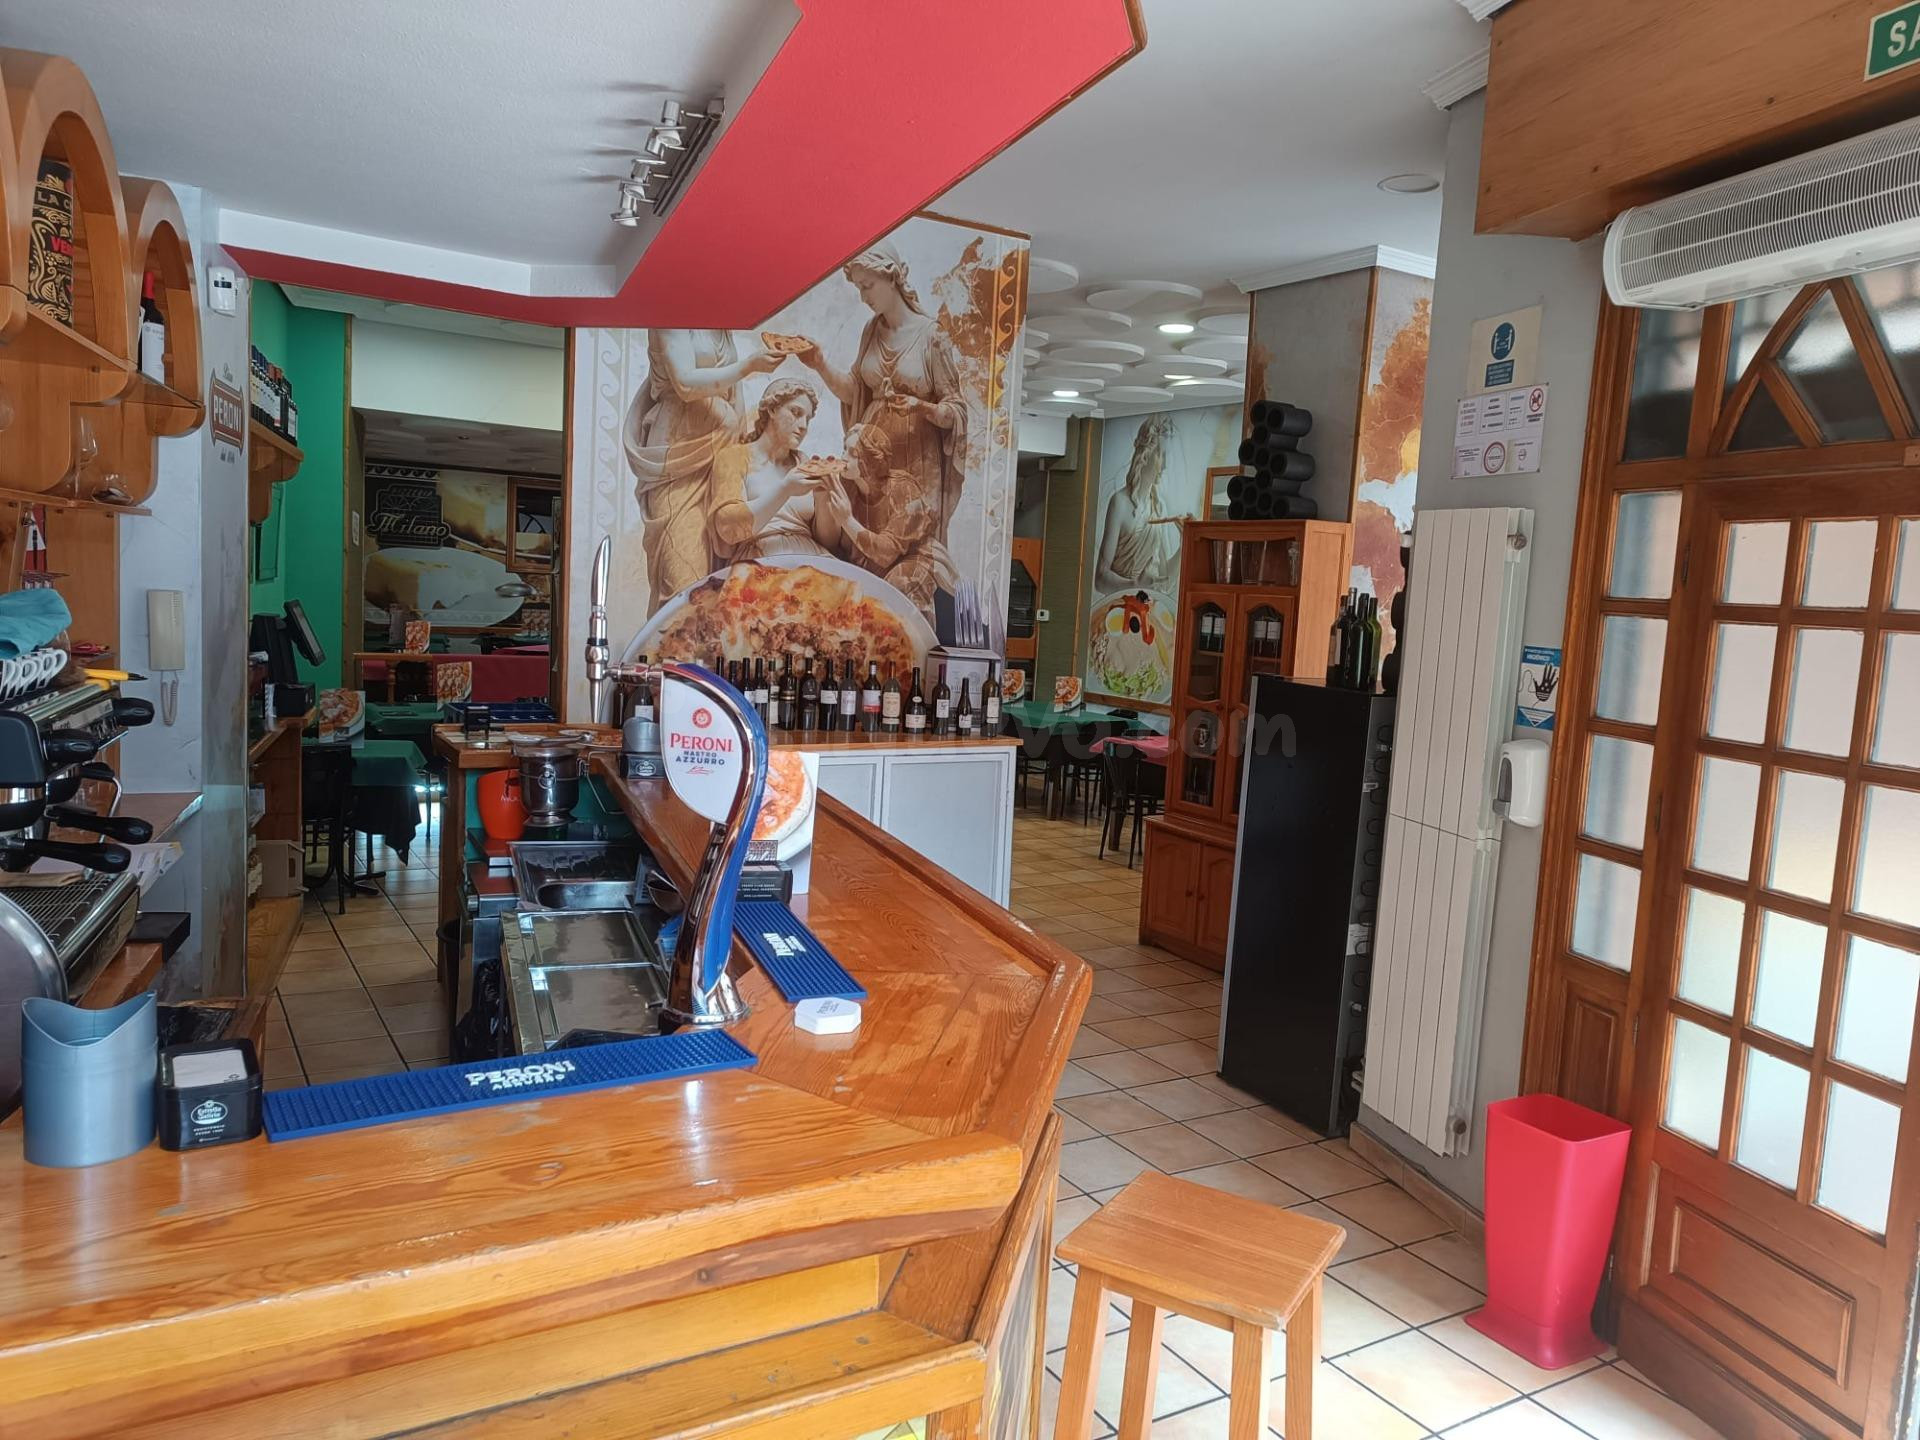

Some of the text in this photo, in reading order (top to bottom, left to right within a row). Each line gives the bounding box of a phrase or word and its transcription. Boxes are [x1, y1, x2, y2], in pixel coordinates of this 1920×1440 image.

[375, 511, 447, 537] Milano
[670, 732, 732, 752] PERONI
[675, 756, 725, 766] AZZURRO
[465, 1060, 576, 1087] PERONI
